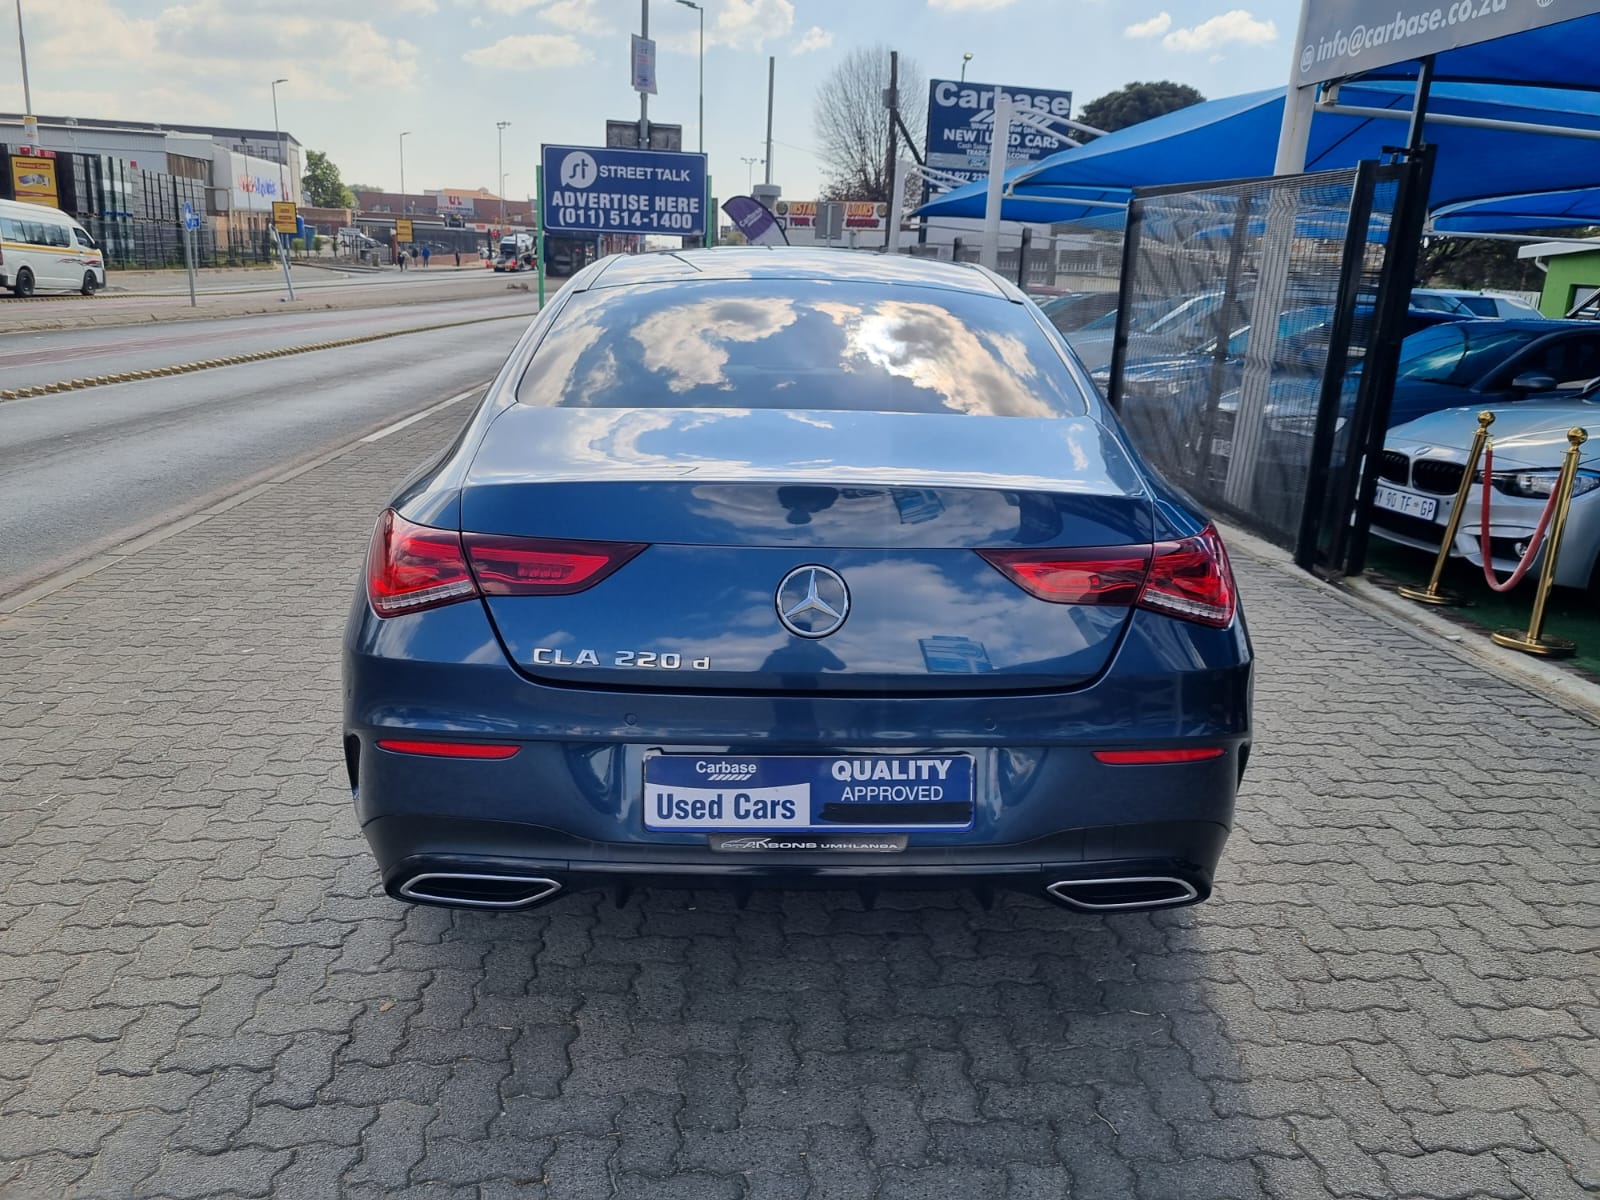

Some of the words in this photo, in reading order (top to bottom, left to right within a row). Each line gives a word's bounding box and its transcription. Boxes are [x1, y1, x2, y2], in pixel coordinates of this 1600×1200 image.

[943, 128, 977, 142] NEW
[1024, 134, 1059, 149] CARS
[600, 165, 653, 180] STREET
[655, 168, 690, 182] TALK
[552, 191, 649, 211] ADVERTISE
[655, 196, 699, 213] HERE
[559, 207, 604, 227] (011)
[610, 210, 692, 229] 514-1400
[1400, 496, 1412, 511] TF
[1421, 501, 1434, 516] GP
[533, 648, 600, 666] CLA
[614, 650, 681, 669] 220
[693, 656, 711, 670] d
[696, 761, 757, 774] Carbase
[831, 760, 953, 781] QUALITY
[841, 786, 944, 802] APPROVED
[656, 793, 723, 820] Used
[733, 793, 797, 820] Cars
